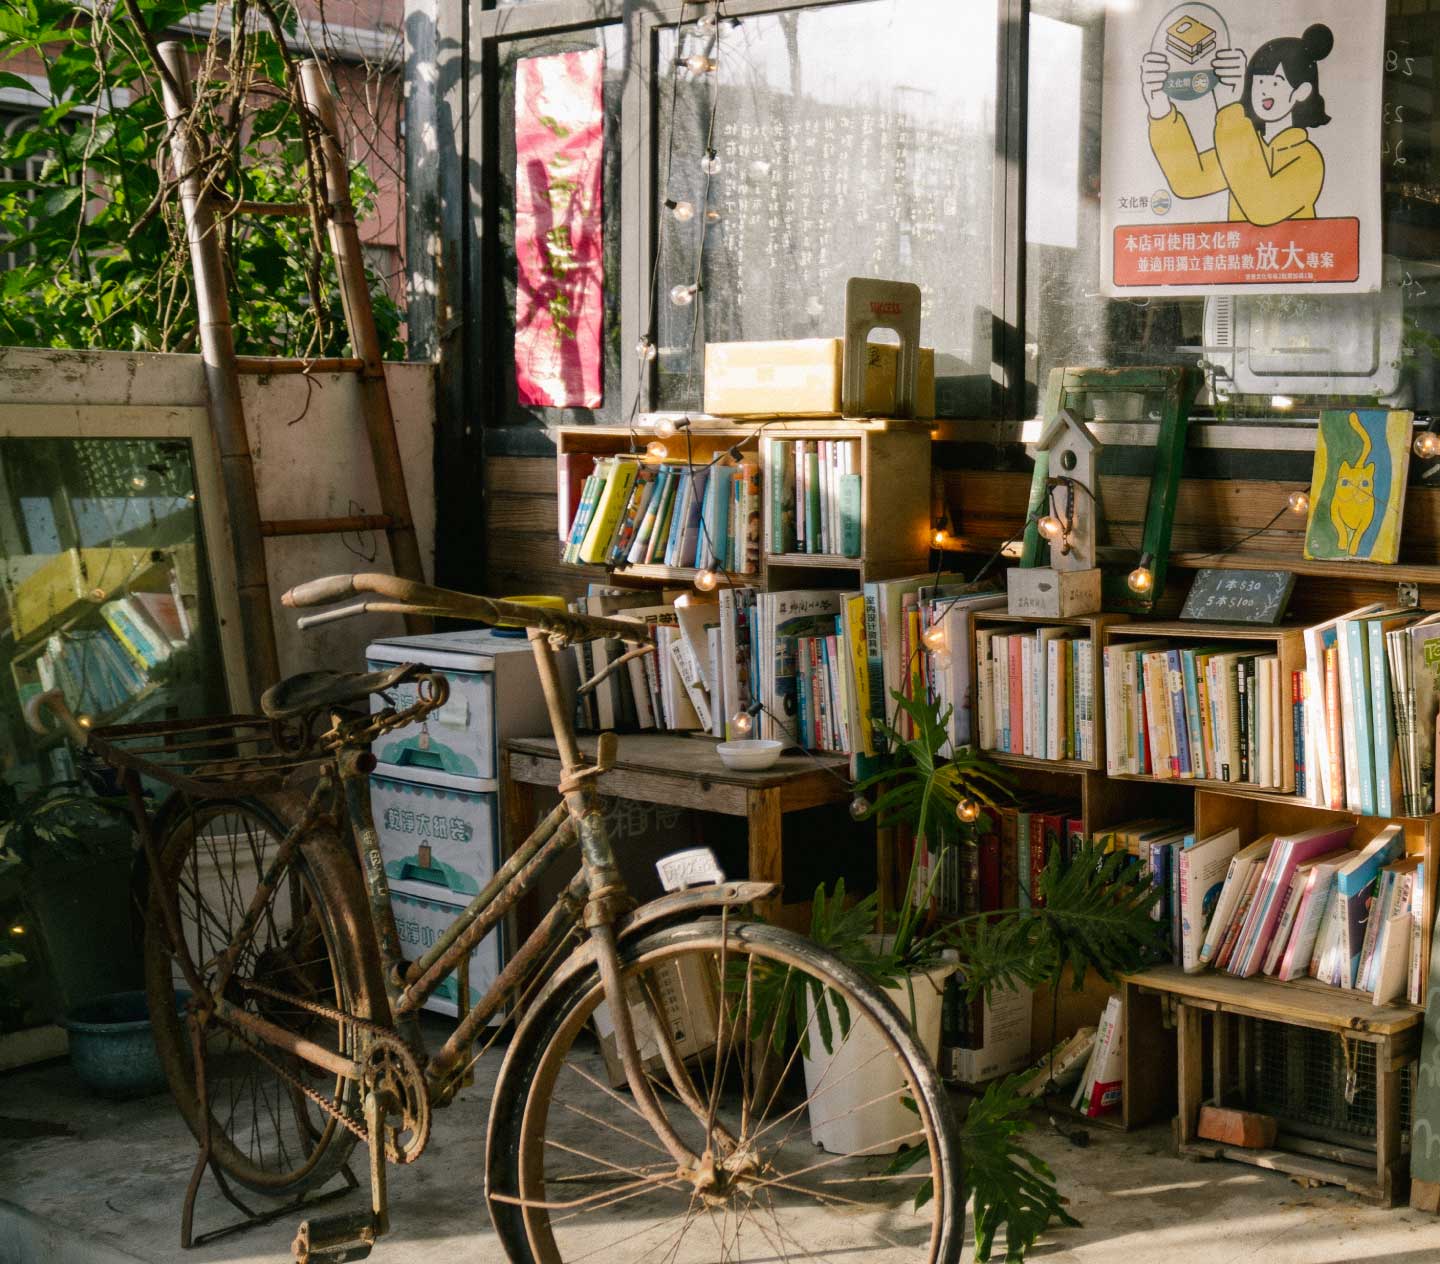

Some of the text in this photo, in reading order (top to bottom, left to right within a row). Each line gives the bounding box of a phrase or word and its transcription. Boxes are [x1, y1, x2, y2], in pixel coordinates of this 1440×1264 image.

[1118, 196, 1149, 209] 文化幣
[1125, 230, 1241, 252] 本店可使用文化幣
